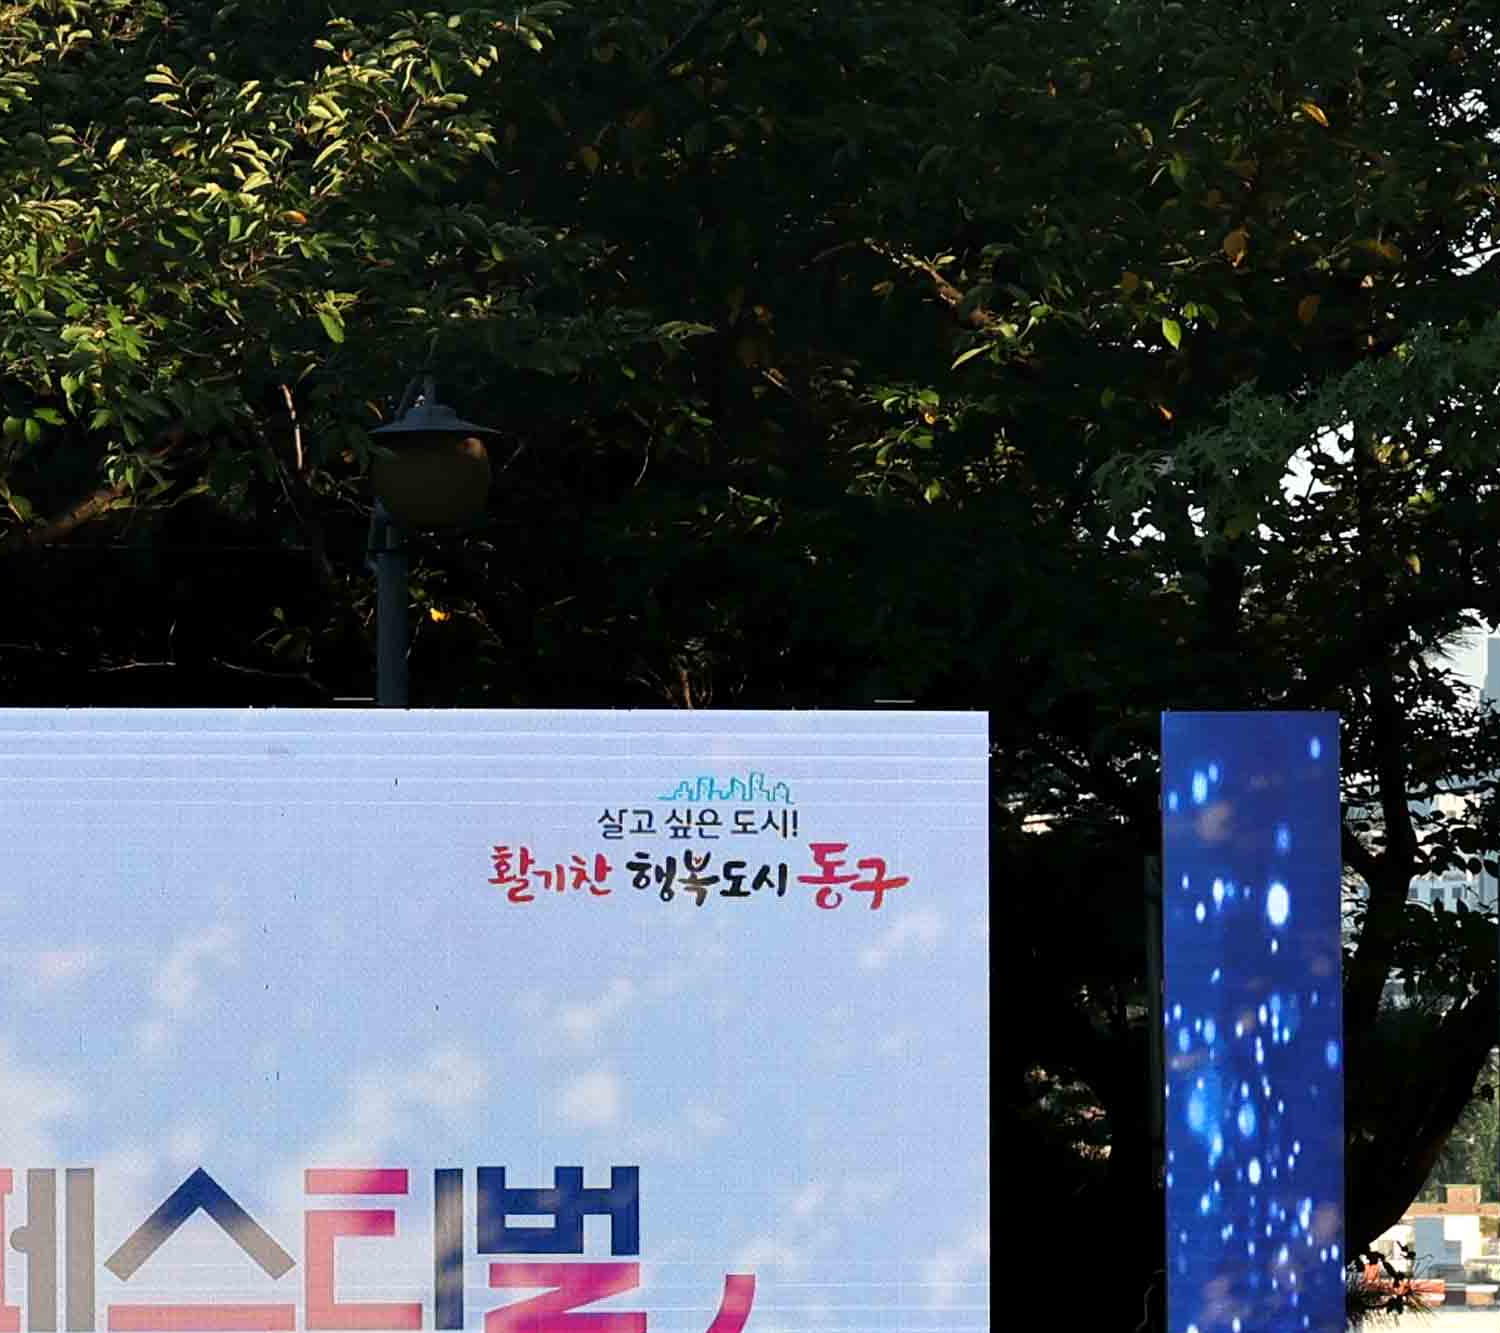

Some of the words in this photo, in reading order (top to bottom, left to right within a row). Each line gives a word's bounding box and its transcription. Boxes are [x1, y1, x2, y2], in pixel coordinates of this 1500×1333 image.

[597, 808, 657, 840] 살고
[665, 808, 722, 840] 싶은
[730, 808, 799, 840] 도시!
[488, 845, 613, 903] 활기찬
[625, 848, 788, 907] 행복도시
[797, 842, 909, 910] 동구
